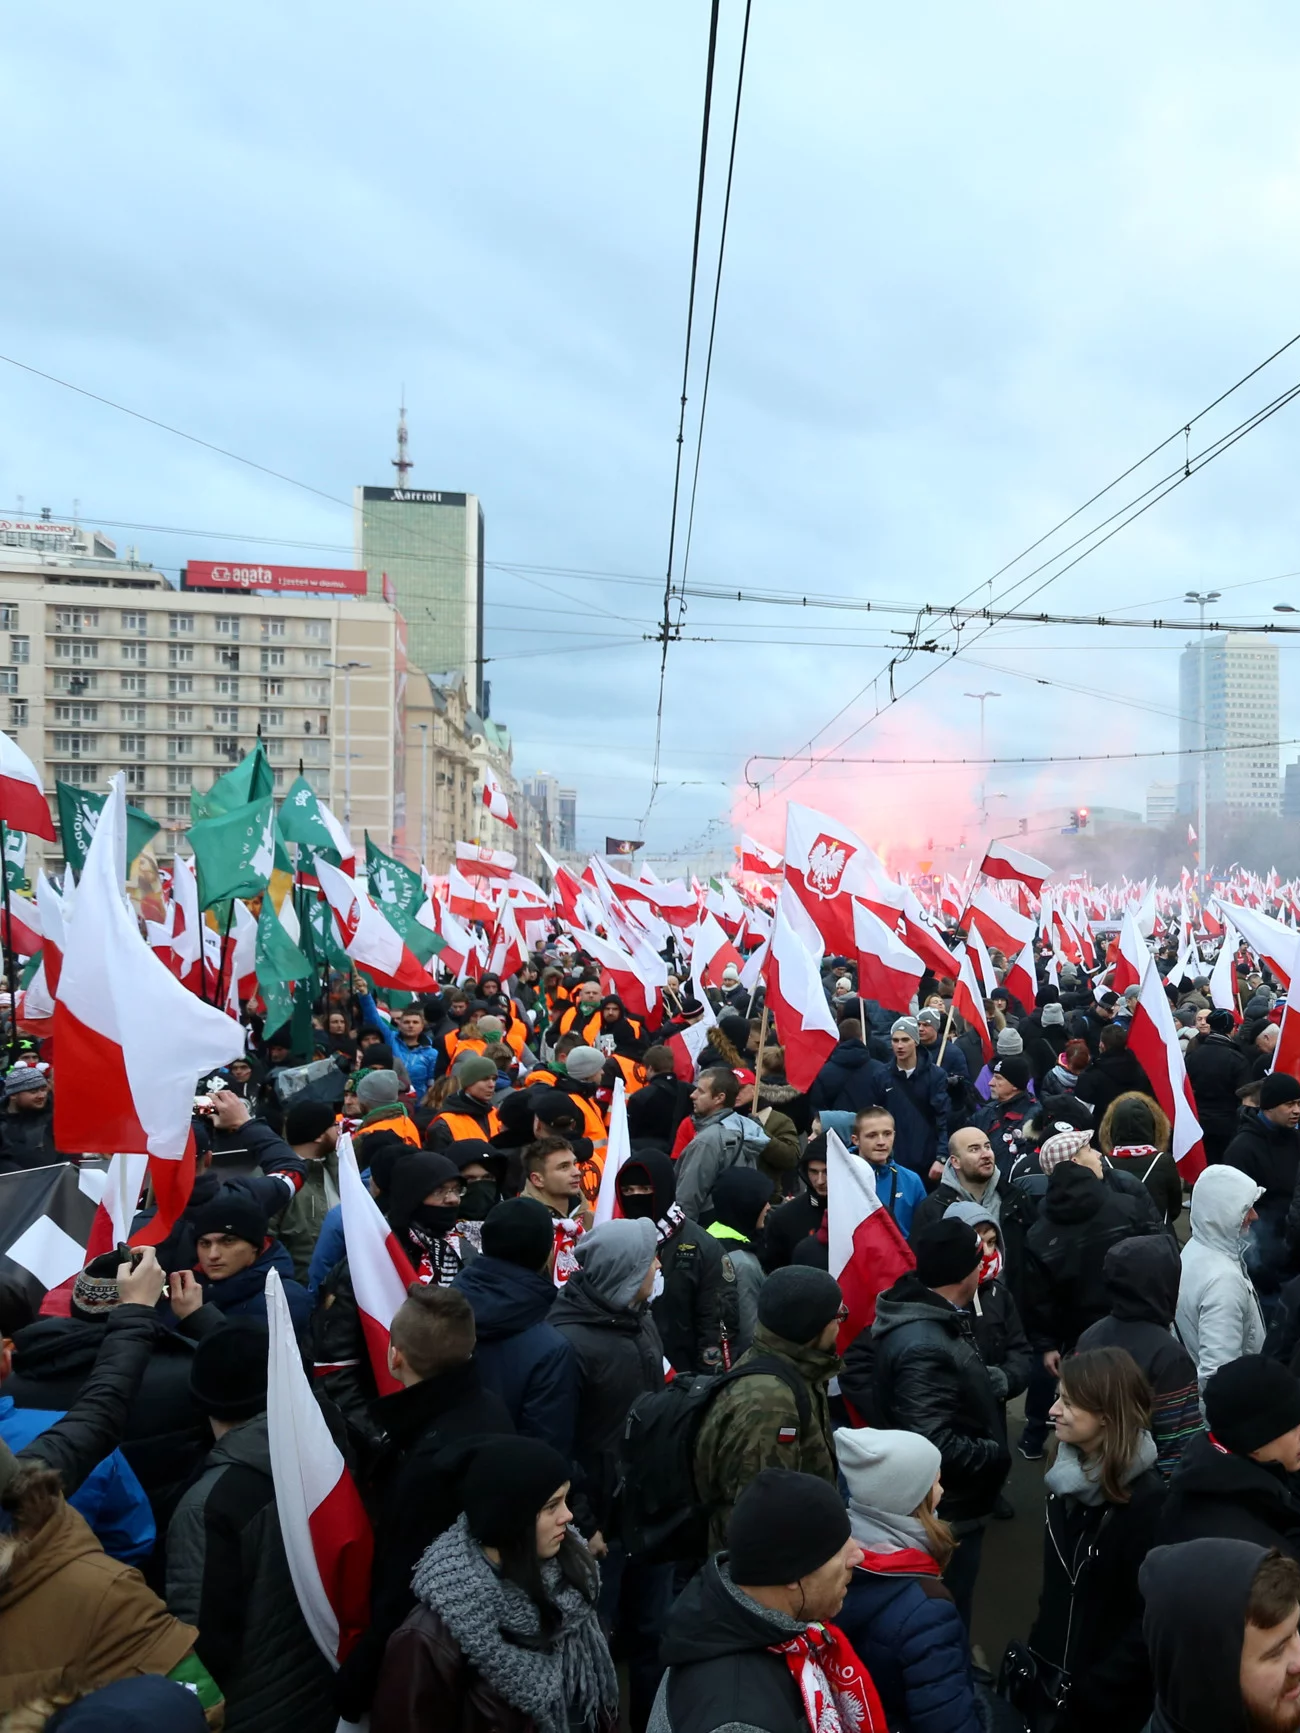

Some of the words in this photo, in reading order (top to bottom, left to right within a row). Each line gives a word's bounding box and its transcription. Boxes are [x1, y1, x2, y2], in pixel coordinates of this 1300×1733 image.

[391, 490, 442, 502] Marriott
[34, 524, 73, 533] MOTORS
[232, 566, 273, 587] agata
